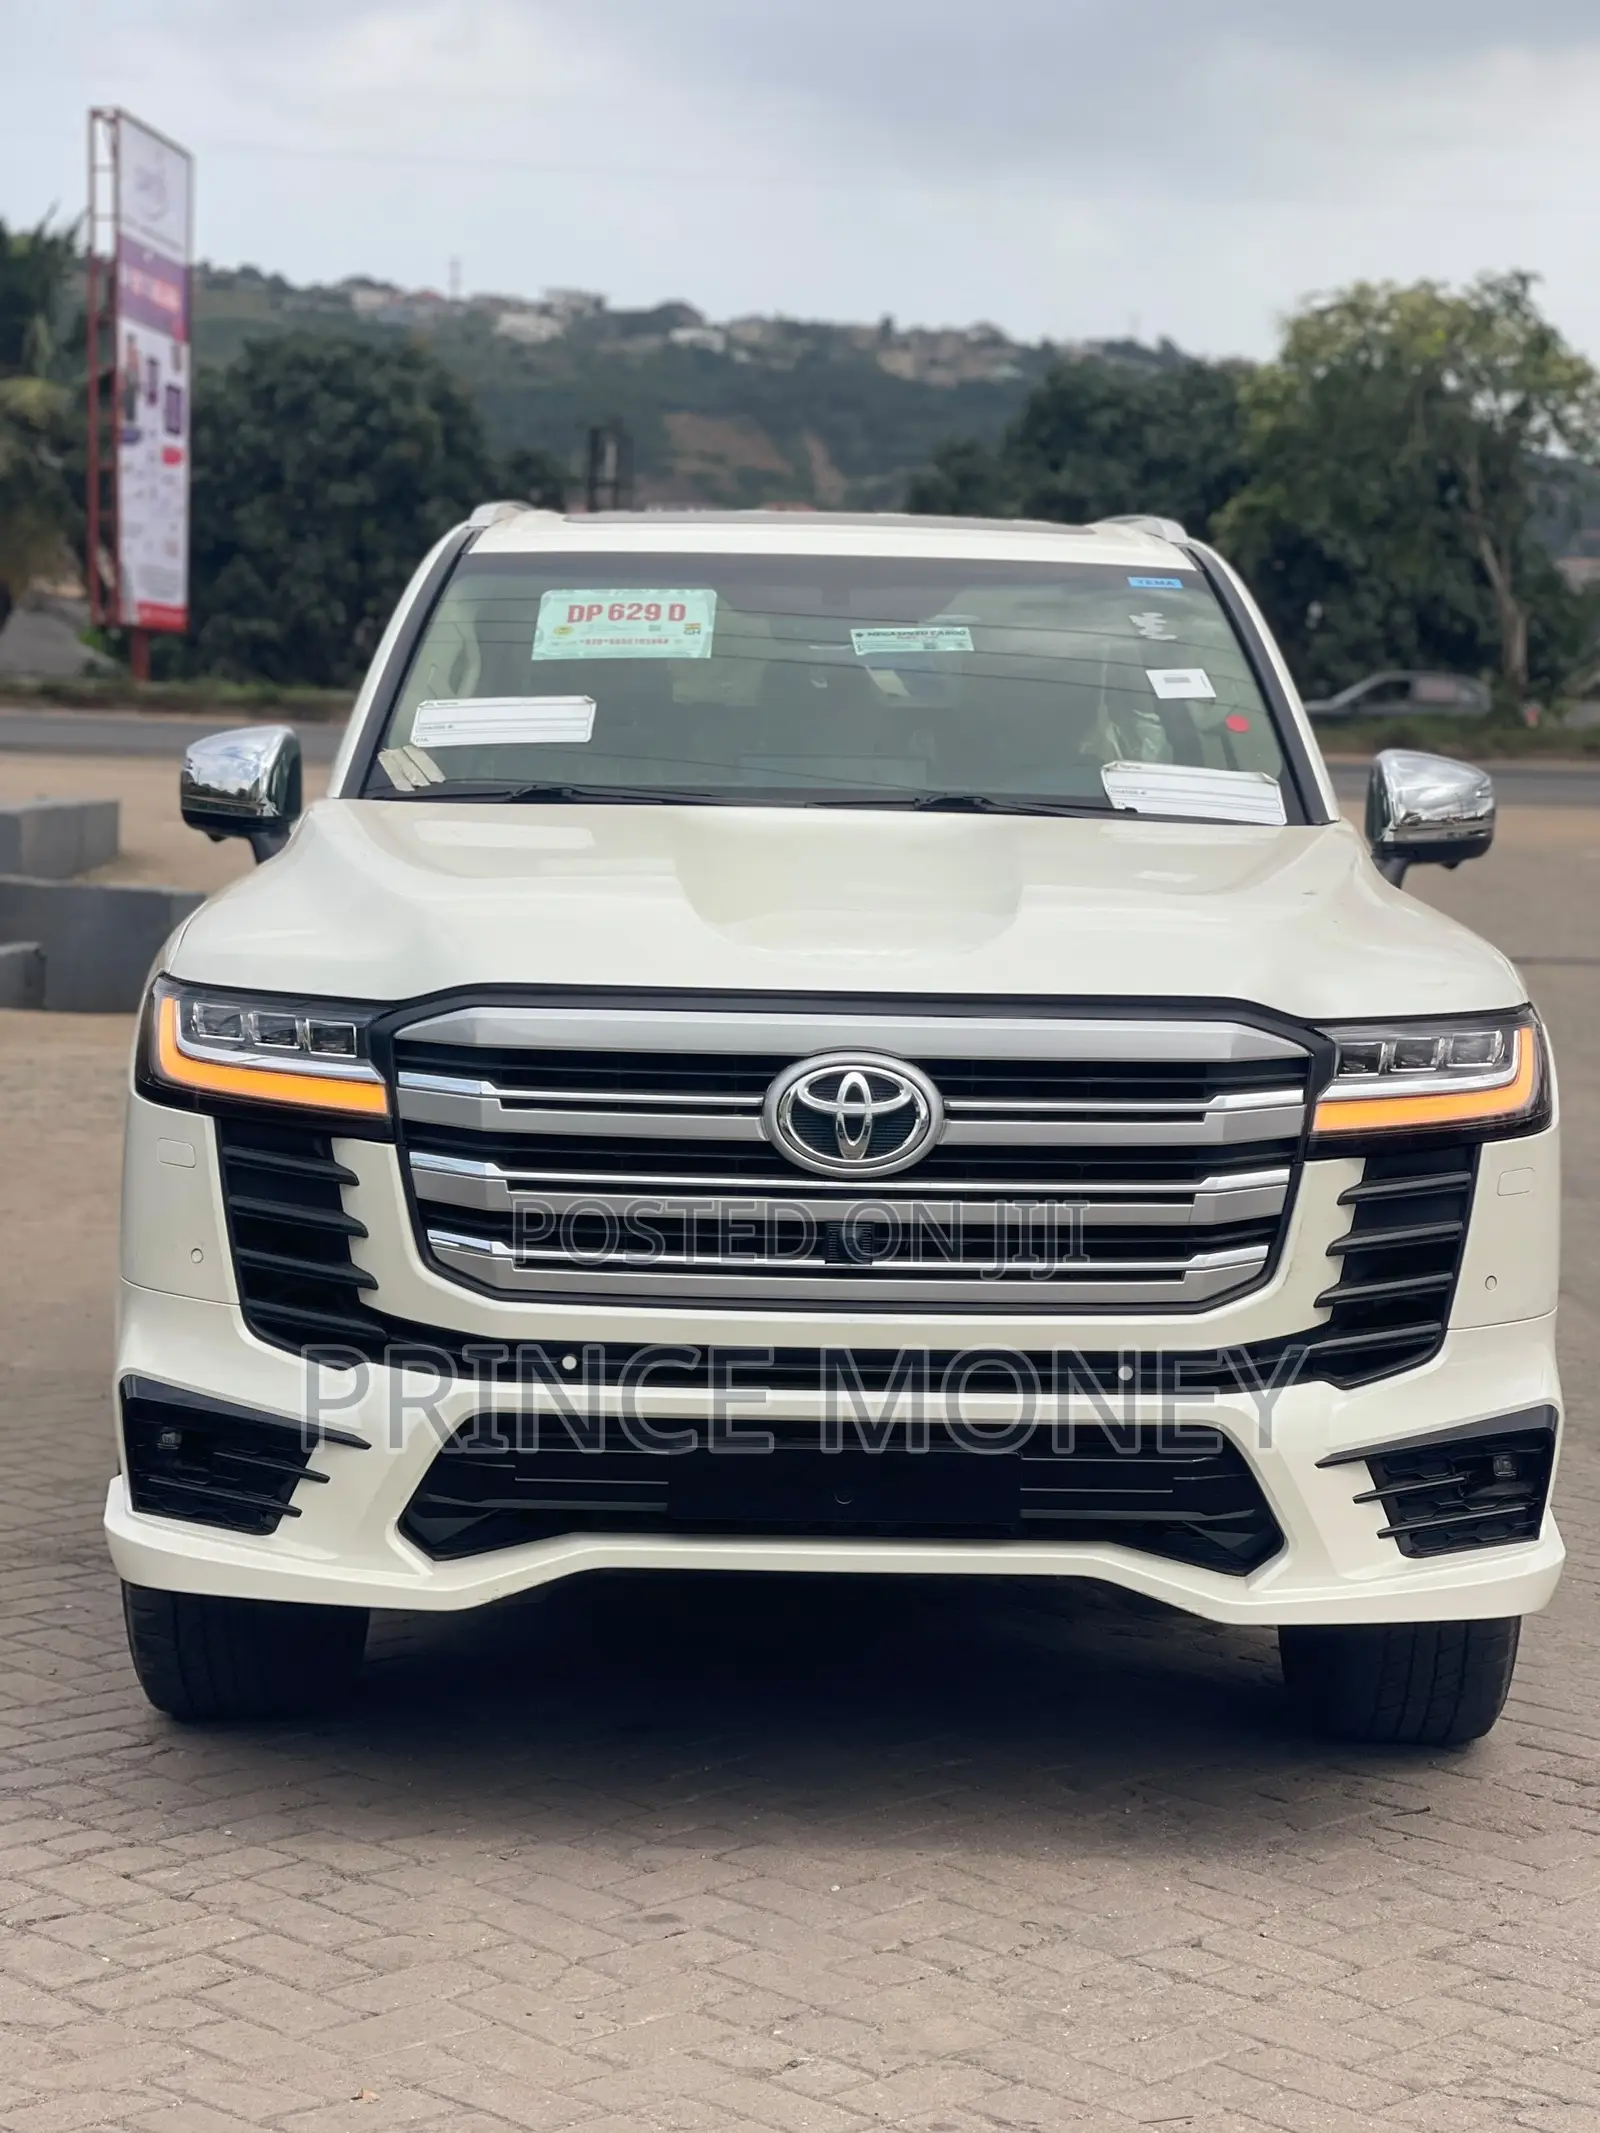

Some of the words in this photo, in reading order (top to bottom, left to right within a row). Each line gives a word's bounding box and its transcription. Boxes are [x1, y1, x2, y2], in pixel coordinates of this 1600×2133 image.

[567, 604, 603, 624] DP
[608, 602, 662, 622] 629
[668, 603, 687, 622] D
